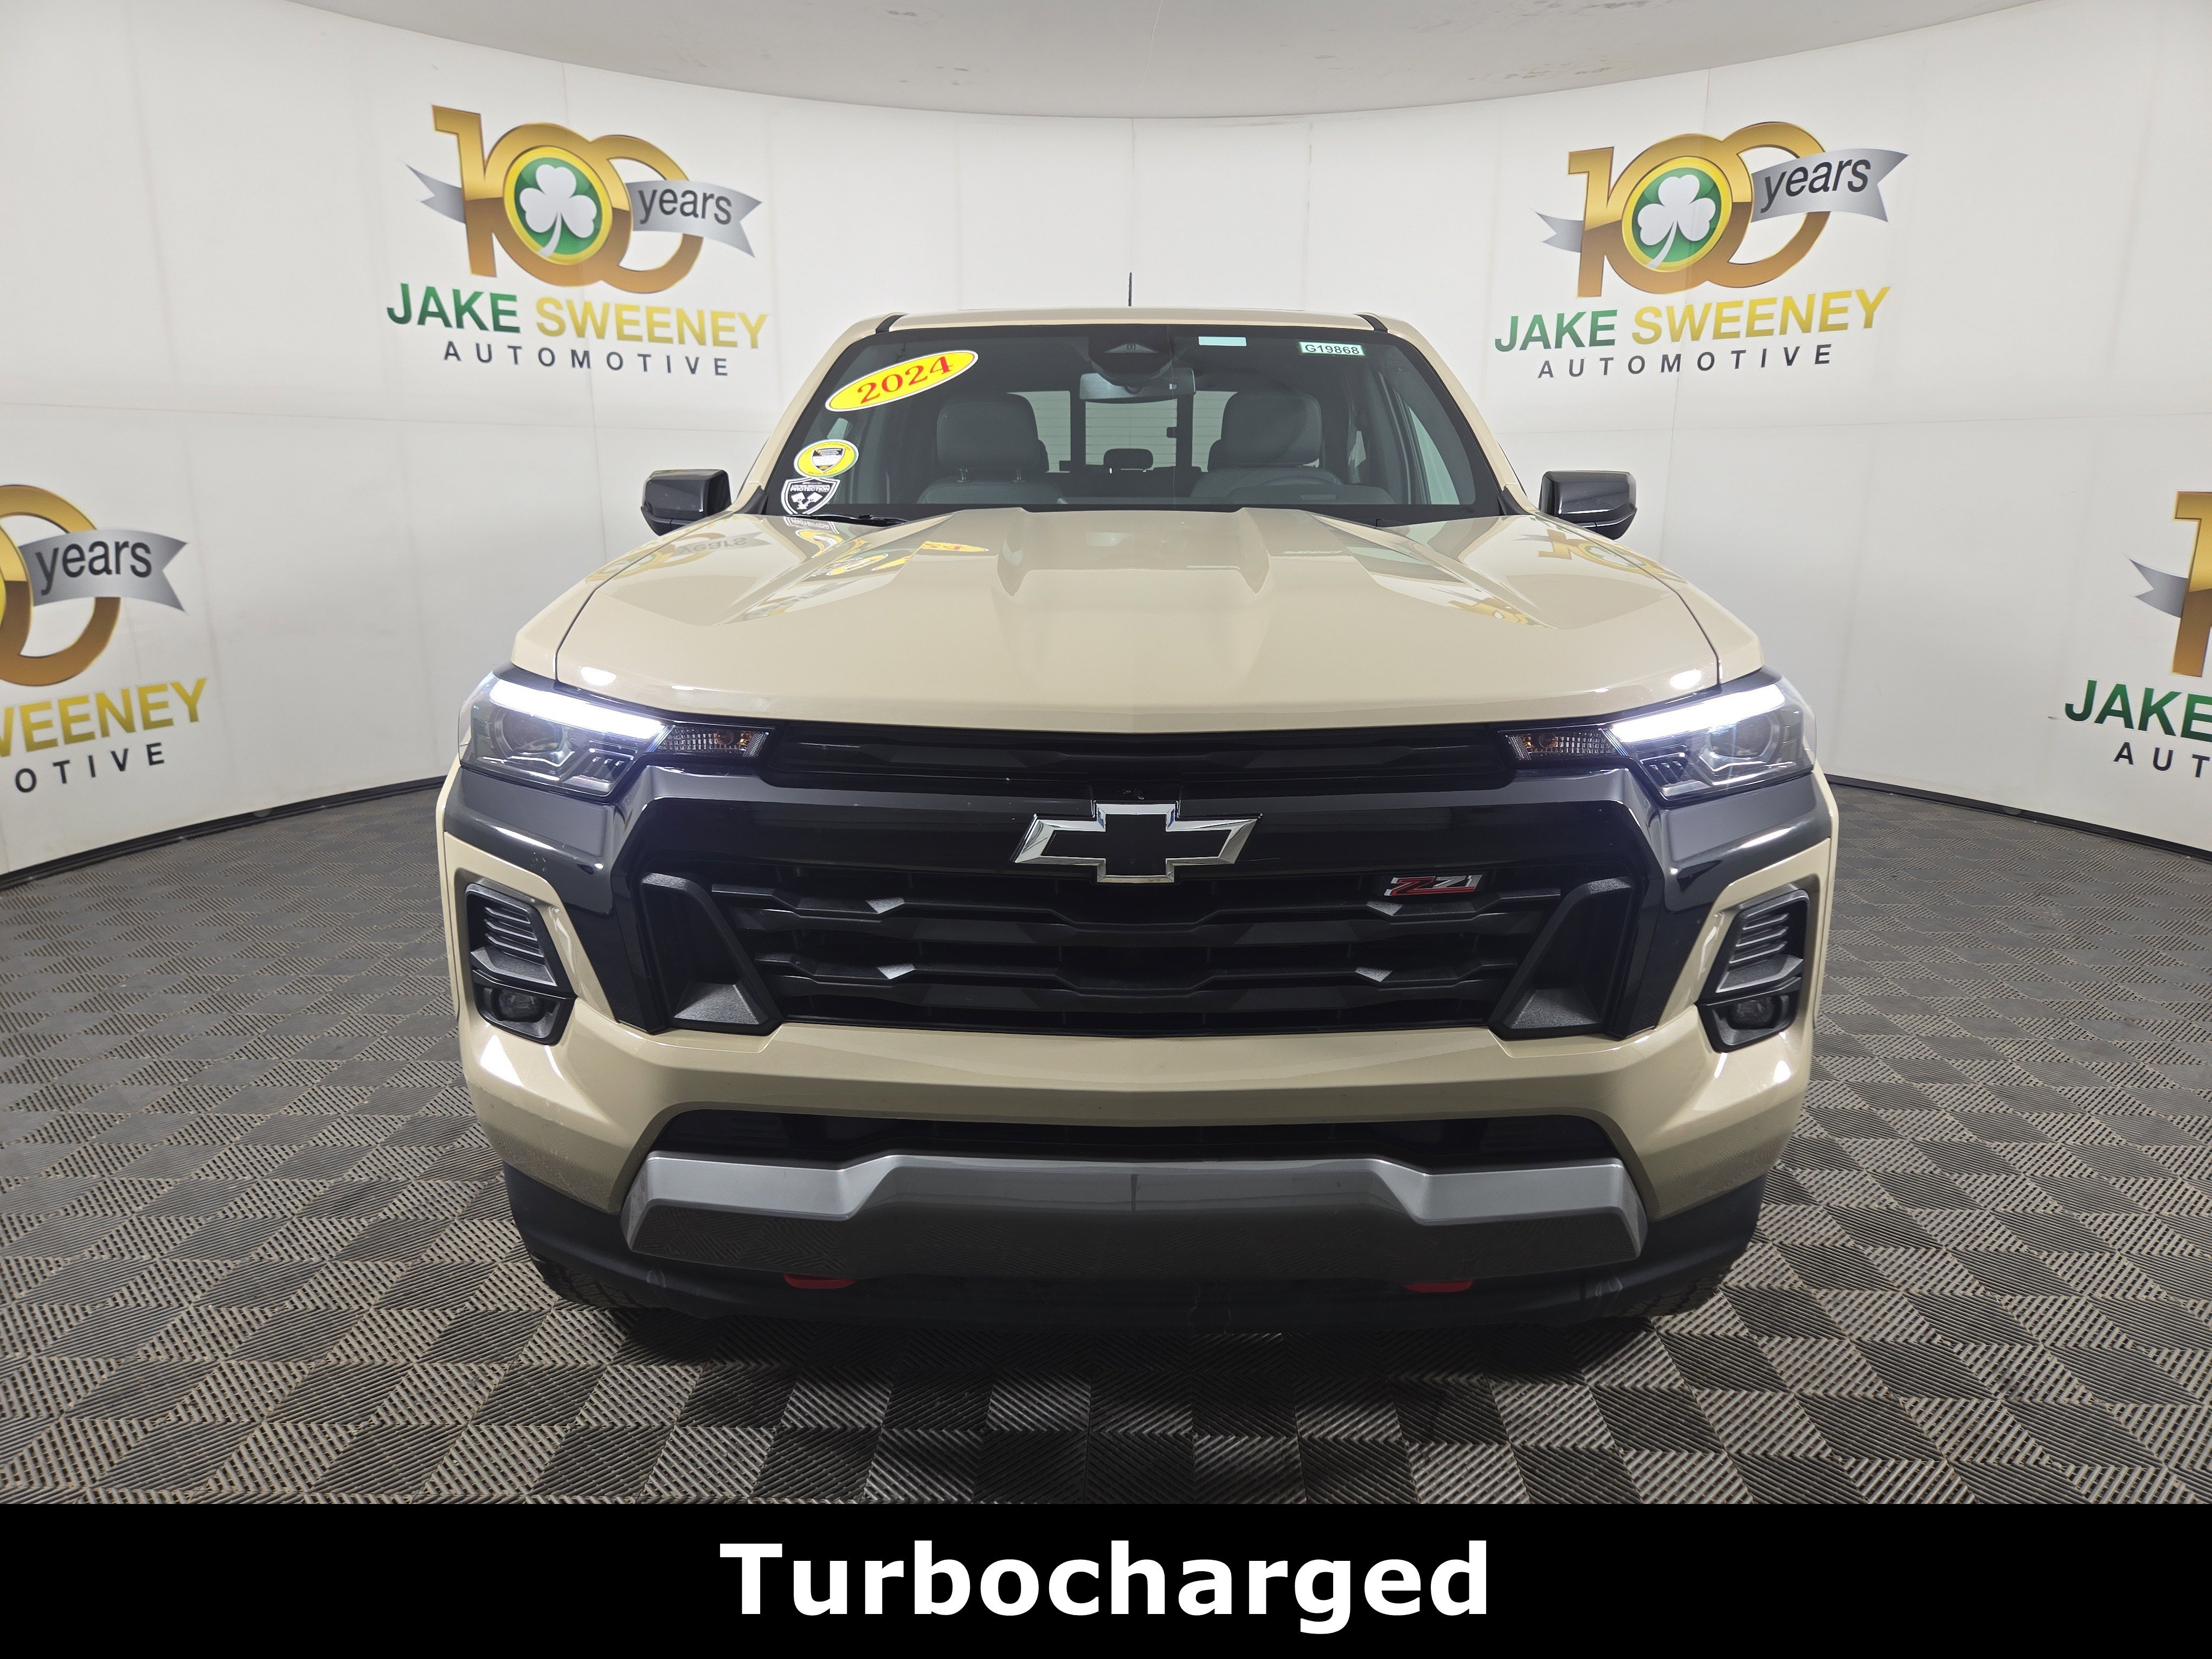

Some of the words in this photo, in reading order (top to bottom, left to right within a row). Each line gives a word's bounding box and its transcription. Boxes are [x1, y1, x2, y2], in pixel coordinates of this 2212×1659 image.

[432, 104, 704, 294] 100
[639, 189, 732, 225] years
[1567, 121, 1831, 298] 100
[1760, 158, 1870, 213] years
[387, 282, 520, 333] JAKE
[536, 297, 768, 349] SWEENEY
[1494, 310, 1617, 352] JAKE
[1631, 286, 1891, 345] SWEENEY
[443, 341, 728, 376] AUTOMOTIVE
[1304, 344, 1360, 354] G19868
[1538, 344, 1832, 378] AUTOMOTIVE
[857, 356, 953, 404] 2024
[36, 541, 152, 595] years
[2065, 679, 2212, 742] JAKE
[1384, 874, 1482, 896] Z71
